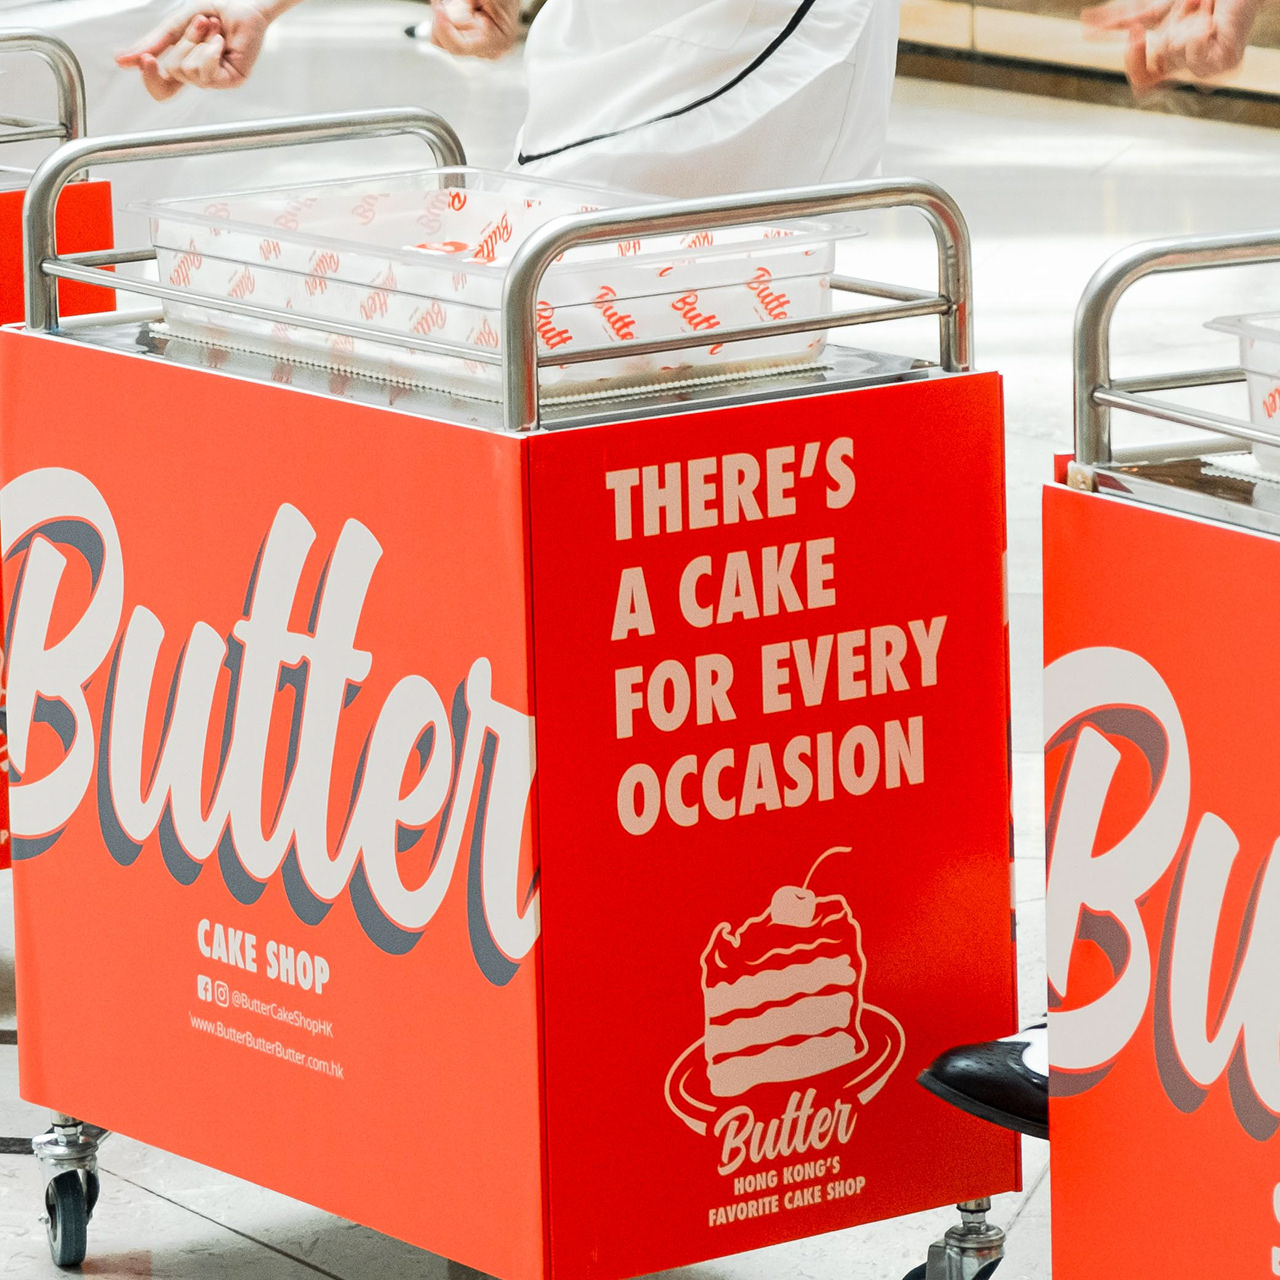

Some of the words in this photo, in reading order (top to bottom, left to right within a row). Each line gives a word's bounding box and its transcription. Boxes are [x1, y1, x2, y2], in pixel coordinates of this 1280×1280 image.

[592, 285, 636, 340] Butte
[745, 266, 791, 320] Butte
[604, 436, 858, 542] THERE'S
[610, 567, 655, 640] A
[677, 538, 837, 627] CAKE
[614, 653, 737, 739] FOR
[761, 614, 949, 714] EVERY
[0, 466, 540, 975] Butter
[616, 715, 926, 837] OCCASION
[197, 918, 258, 973] CAKE
[265, 940, 331, 995] SHOP
[189, 1014, 345, 1080] www.ButterButterButter.com.hk
[231, 990, 334, 1038] @ButterCakeShopHK
[713, 1087, 858, 1177] Butter
[707, 1195, 779, 1227] FAVORITE
[783, 1185, 822, 1210] CAKE
[826, 1176, 866, 1200] SHOP
[733, 1169, 778, 1196] HONG
[782, 1155, 841, 1184] KONG'S
